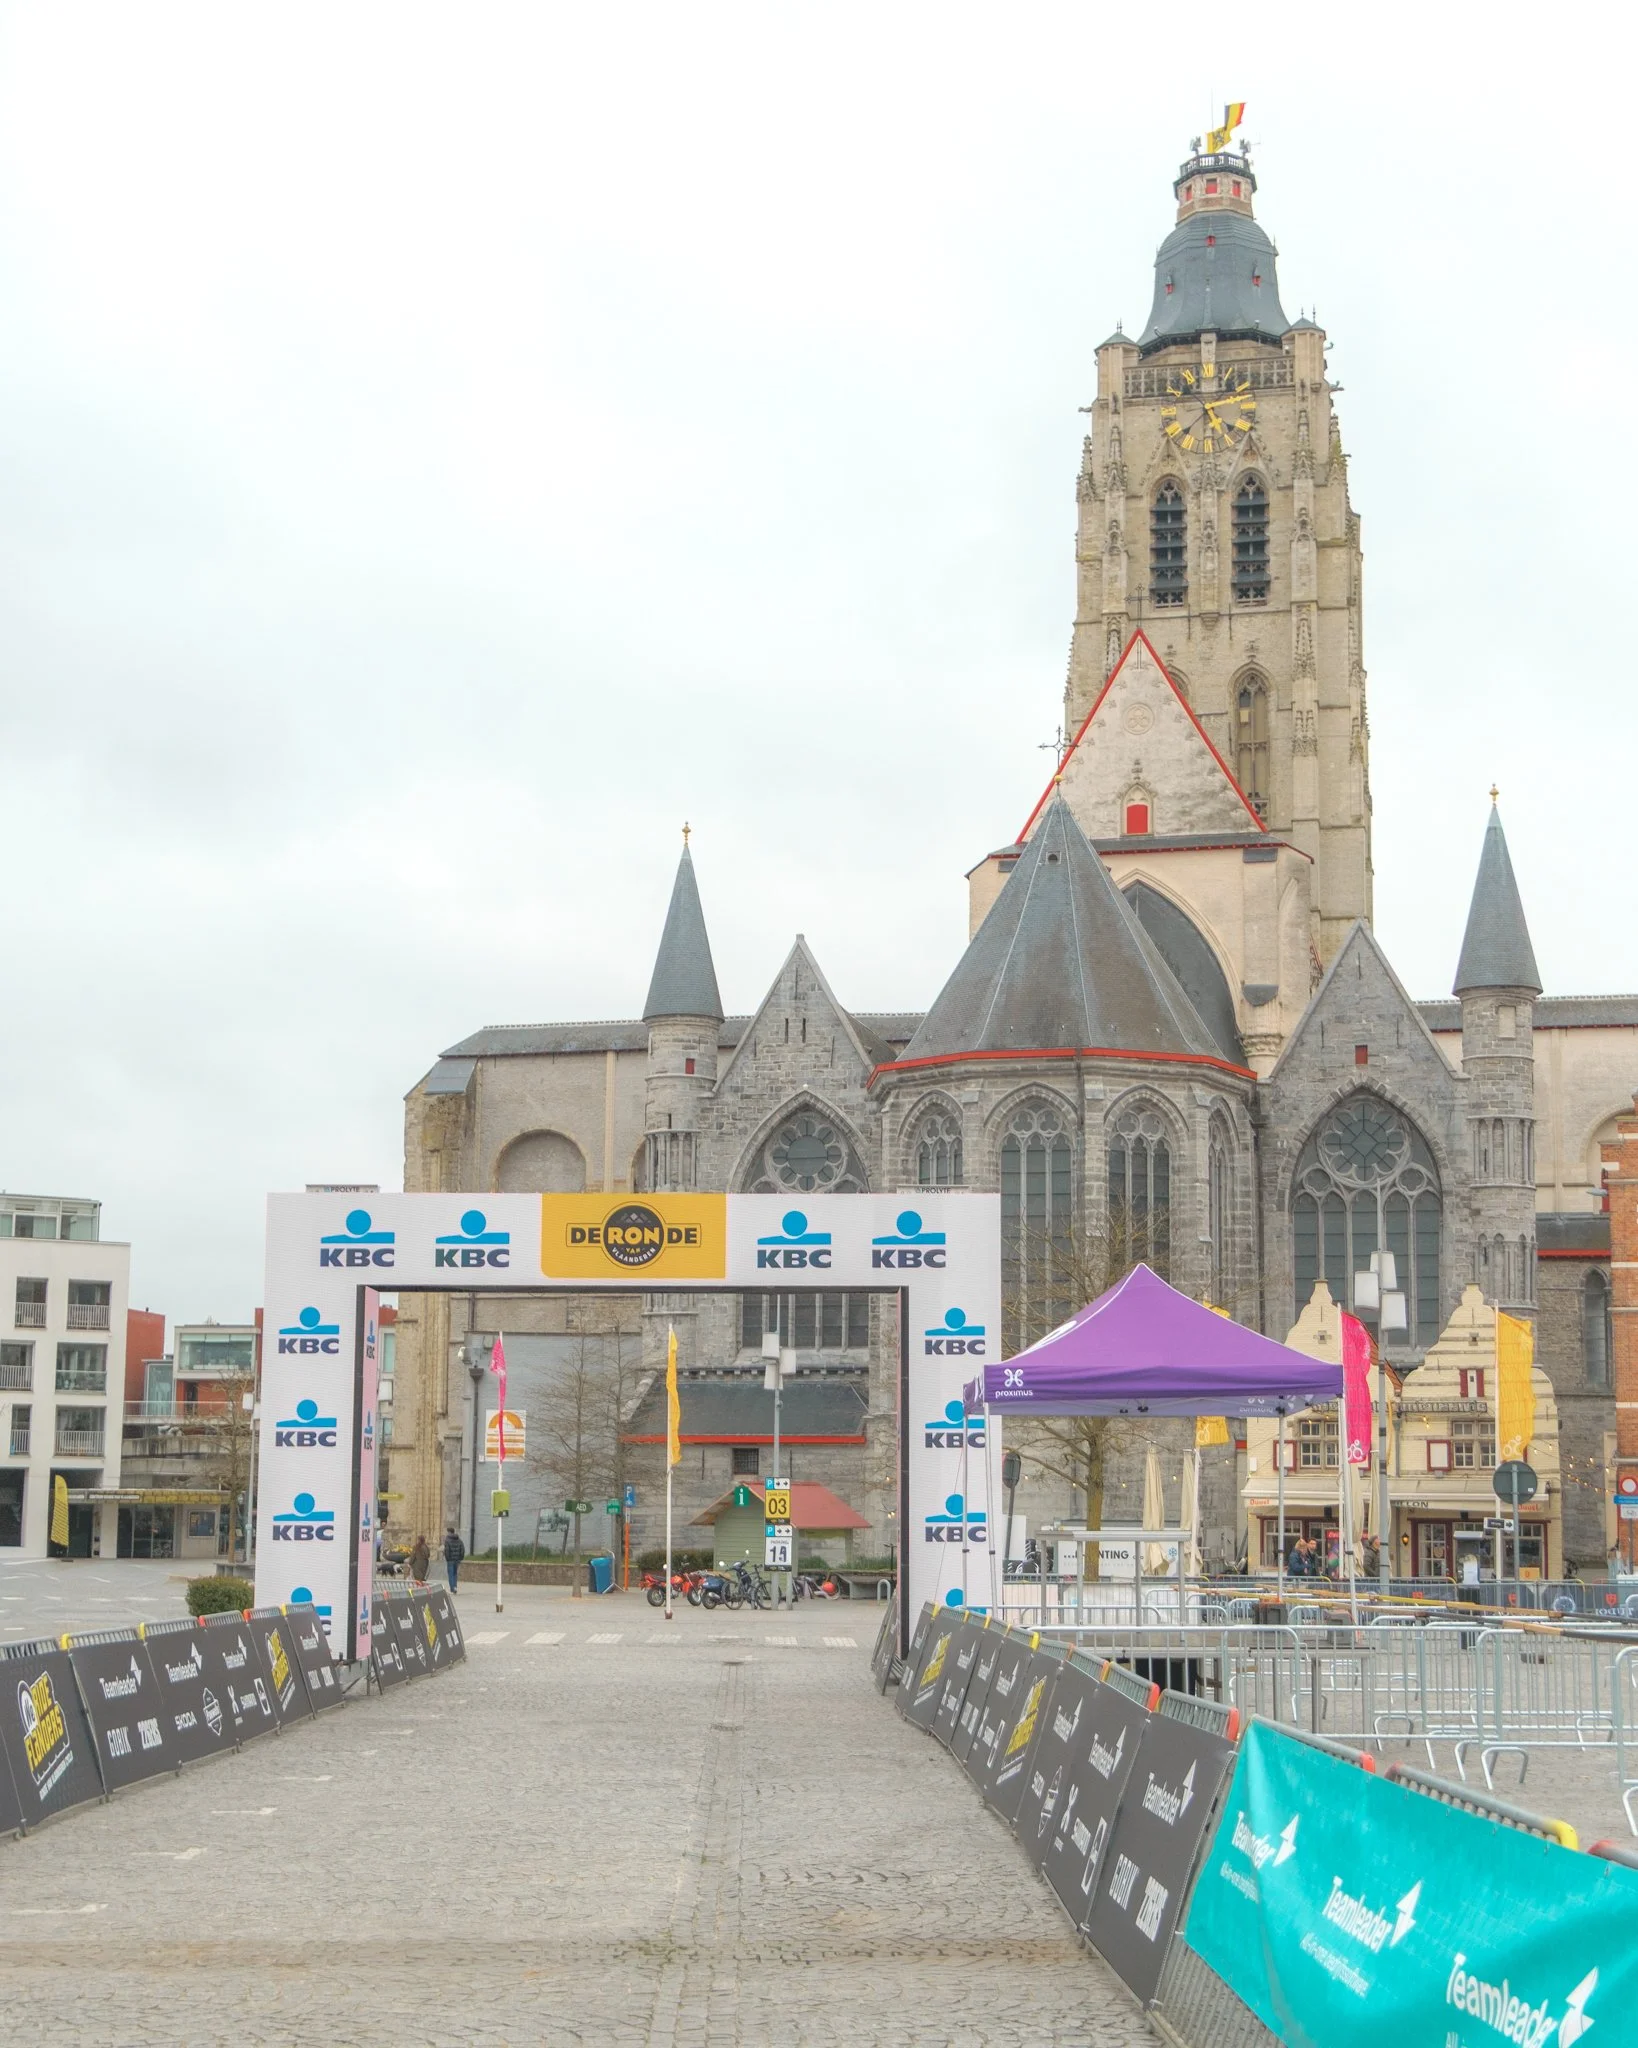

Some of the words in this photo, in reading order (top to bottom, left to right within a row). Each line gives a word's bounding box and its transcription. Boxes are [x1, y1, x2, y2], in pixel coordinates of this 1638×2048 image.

[921, 1186, 951, 1194] PROLYTE
[571, 1227, 601, 1244] DE
[320, 1247, 395, 1268] KBC
[435, 1248, 510, 1268] KBC
[611, 1246, 657, 1264] VLAANDEREN
[757, 1249, 832, 1268] KBC
[872, 1249, 946, 1268] KBC
[278, 1338, 340, 1354] KBC
[366, 1344, 375, 1360] KBC
[924, 1339, 986, 1355] KBC
[995, 1389, 1034, 1399] proximus
[275, 1431, 337, 1447] KBC
[363, 1436, 373, 1451] KBC
[925, 1432, 986, 1448] KBC
[767, 1479, 773, 1488] P
[576, 1503, 587, 1512] AED
[768, 1498, 787, 1515] 03
[272, 1525, 334, 1541] KBC
[362, 1528, 371, 1543] KBC
[767, 1527, 773, 1535] P
[925, 1526, 987, 1542] KBC
[360, 1619, 369, 1635] KBC
[165, 1659, 198, 1683] Teamleader
[99, 1674, 137, 1699] Teamleader
[32, 1674, 52, 1718] RIDE
[107, 1726, 132, 1757] GOBIK
[1142, 1772, 1181, 1826] Teamleader
[1322, 1876, 1394, 1954] Teamleader
[1446, 1952, 1558, 2048] Teamleader
